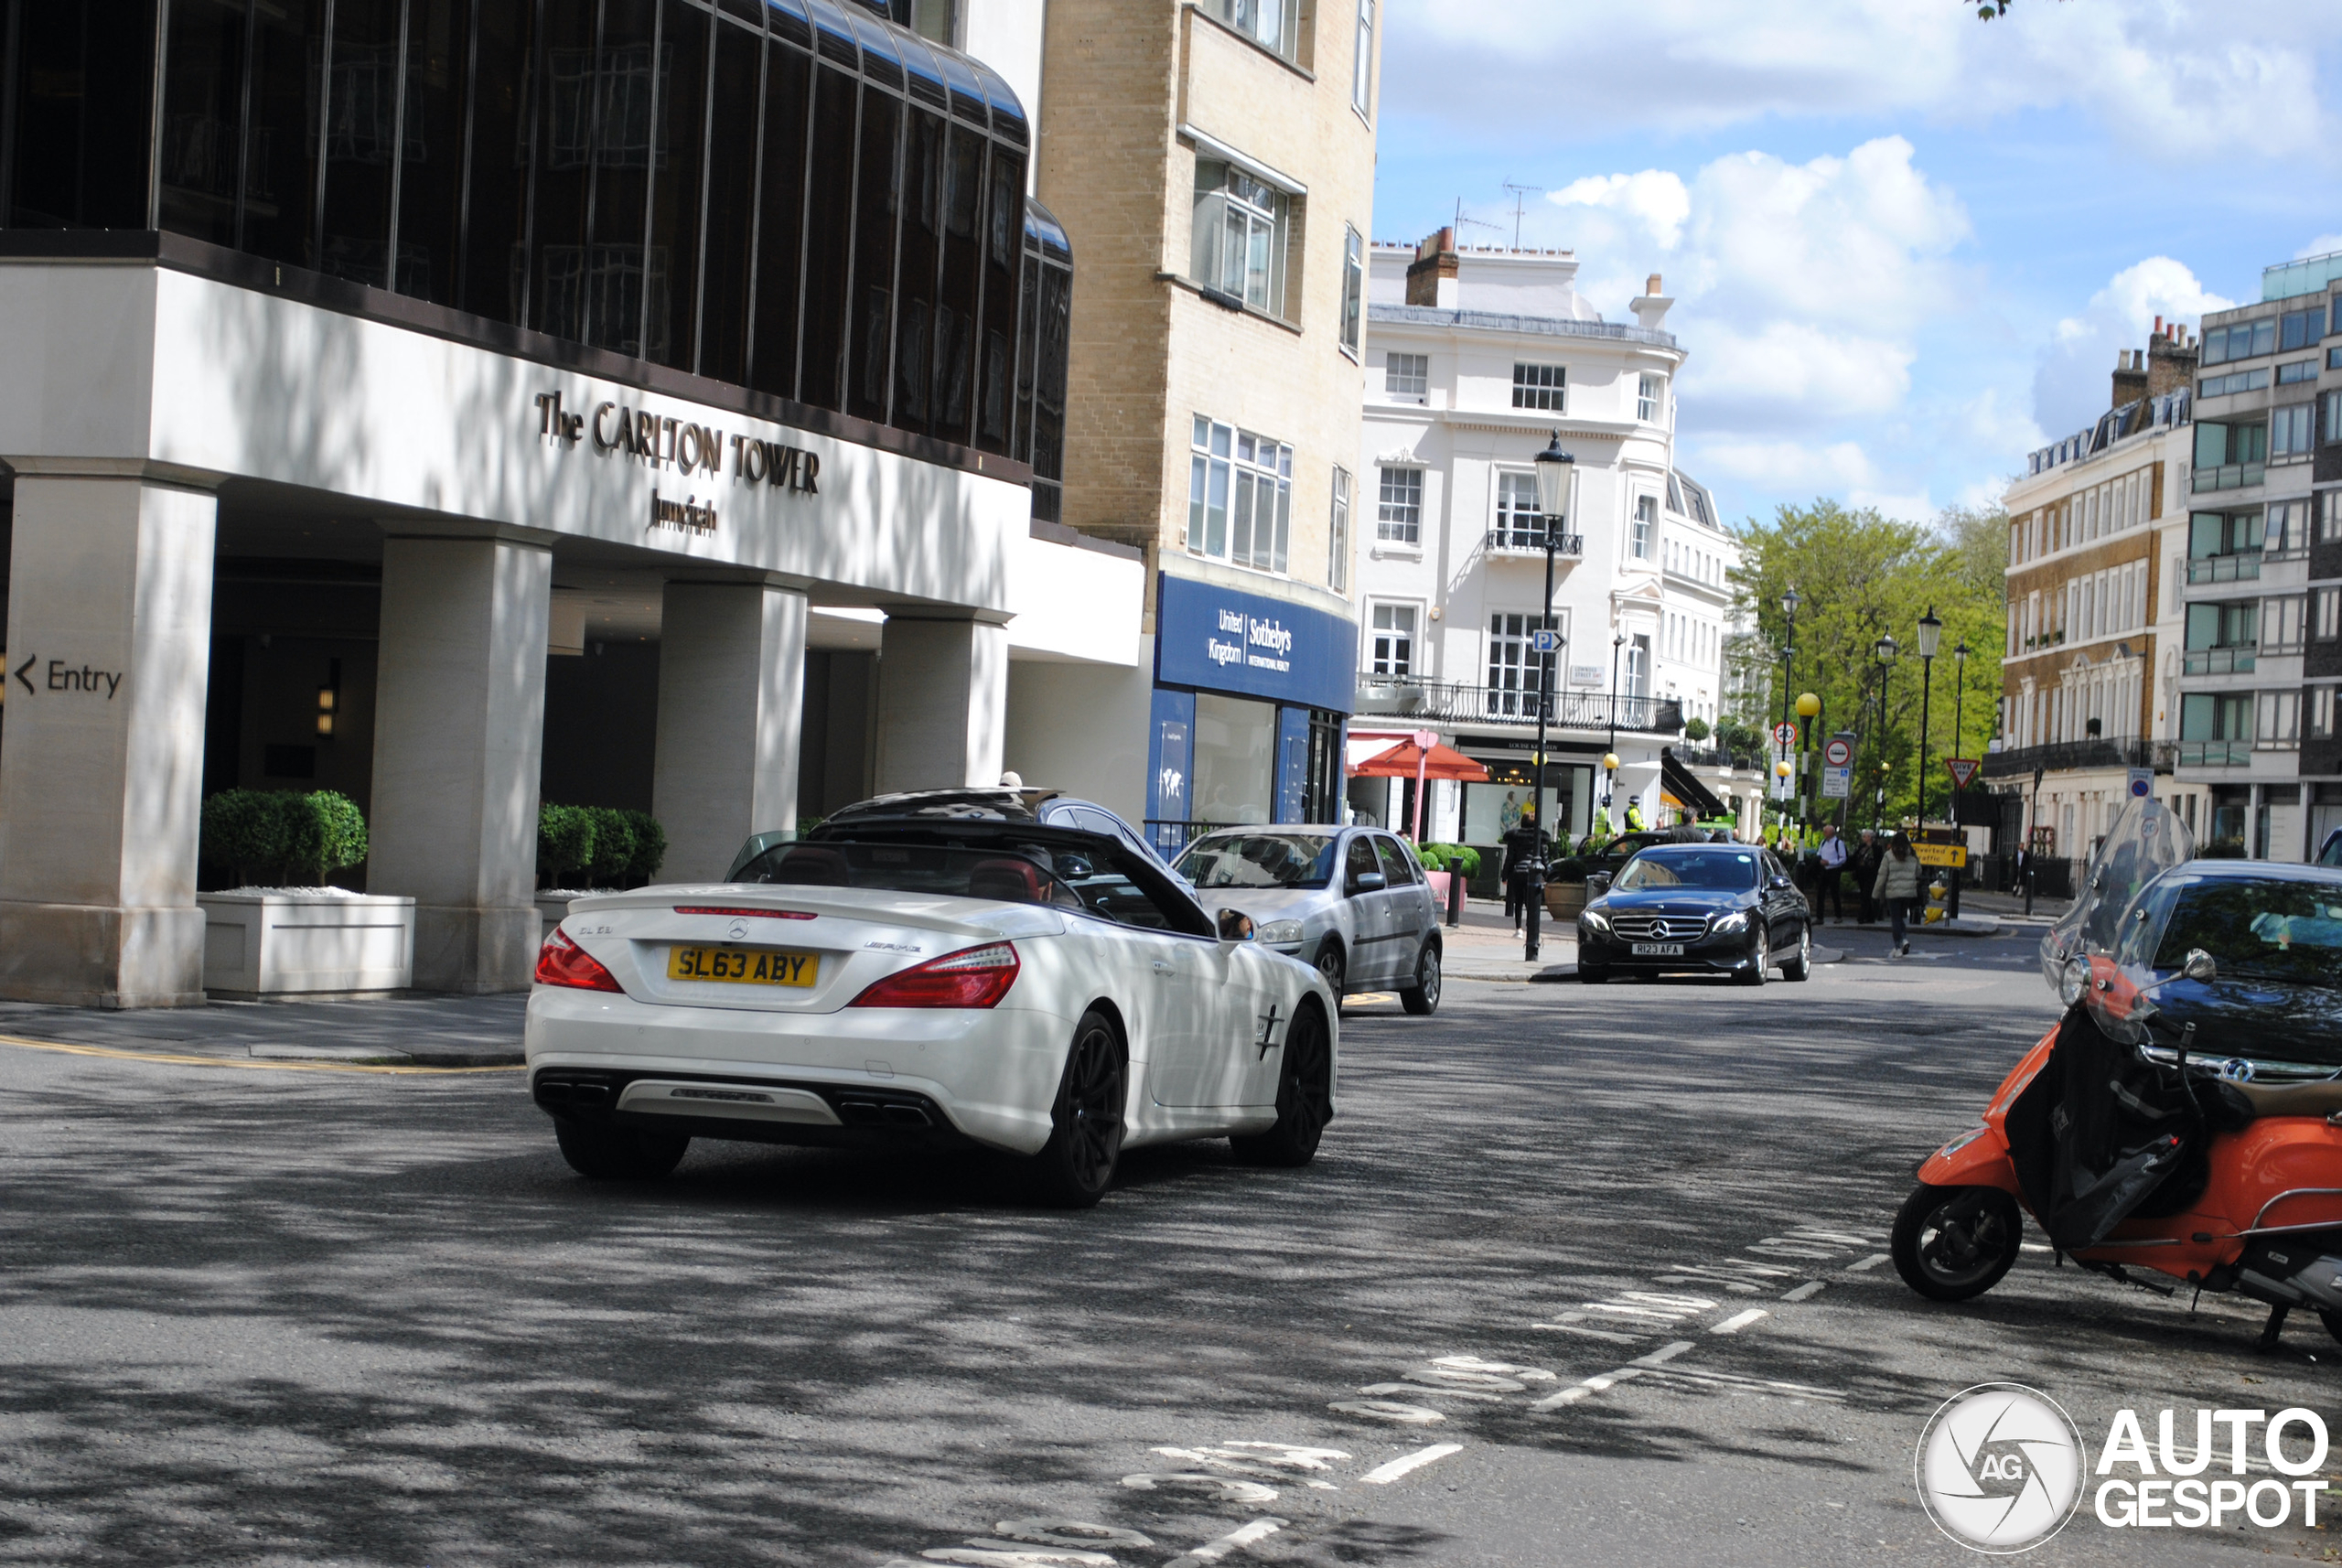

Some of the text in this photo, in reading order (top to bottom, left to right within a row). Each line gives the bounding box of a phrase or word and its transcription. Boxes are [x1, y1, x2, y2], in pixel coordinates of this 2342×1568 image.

[534, 391, 820, 494] The CARLTON TOWER
[1219, 608, 1243, 633] United
[1209, 637, 1241, 666] Kingdom
[1250, 618, 1292, 656] Sotheby's
[48, 660, 122, 699] Entry
[1778, 728, 1793, 738] 20
[1660, 945, 1679, 953] AFA
[678, 950, 806, 982] SL63 ABY
